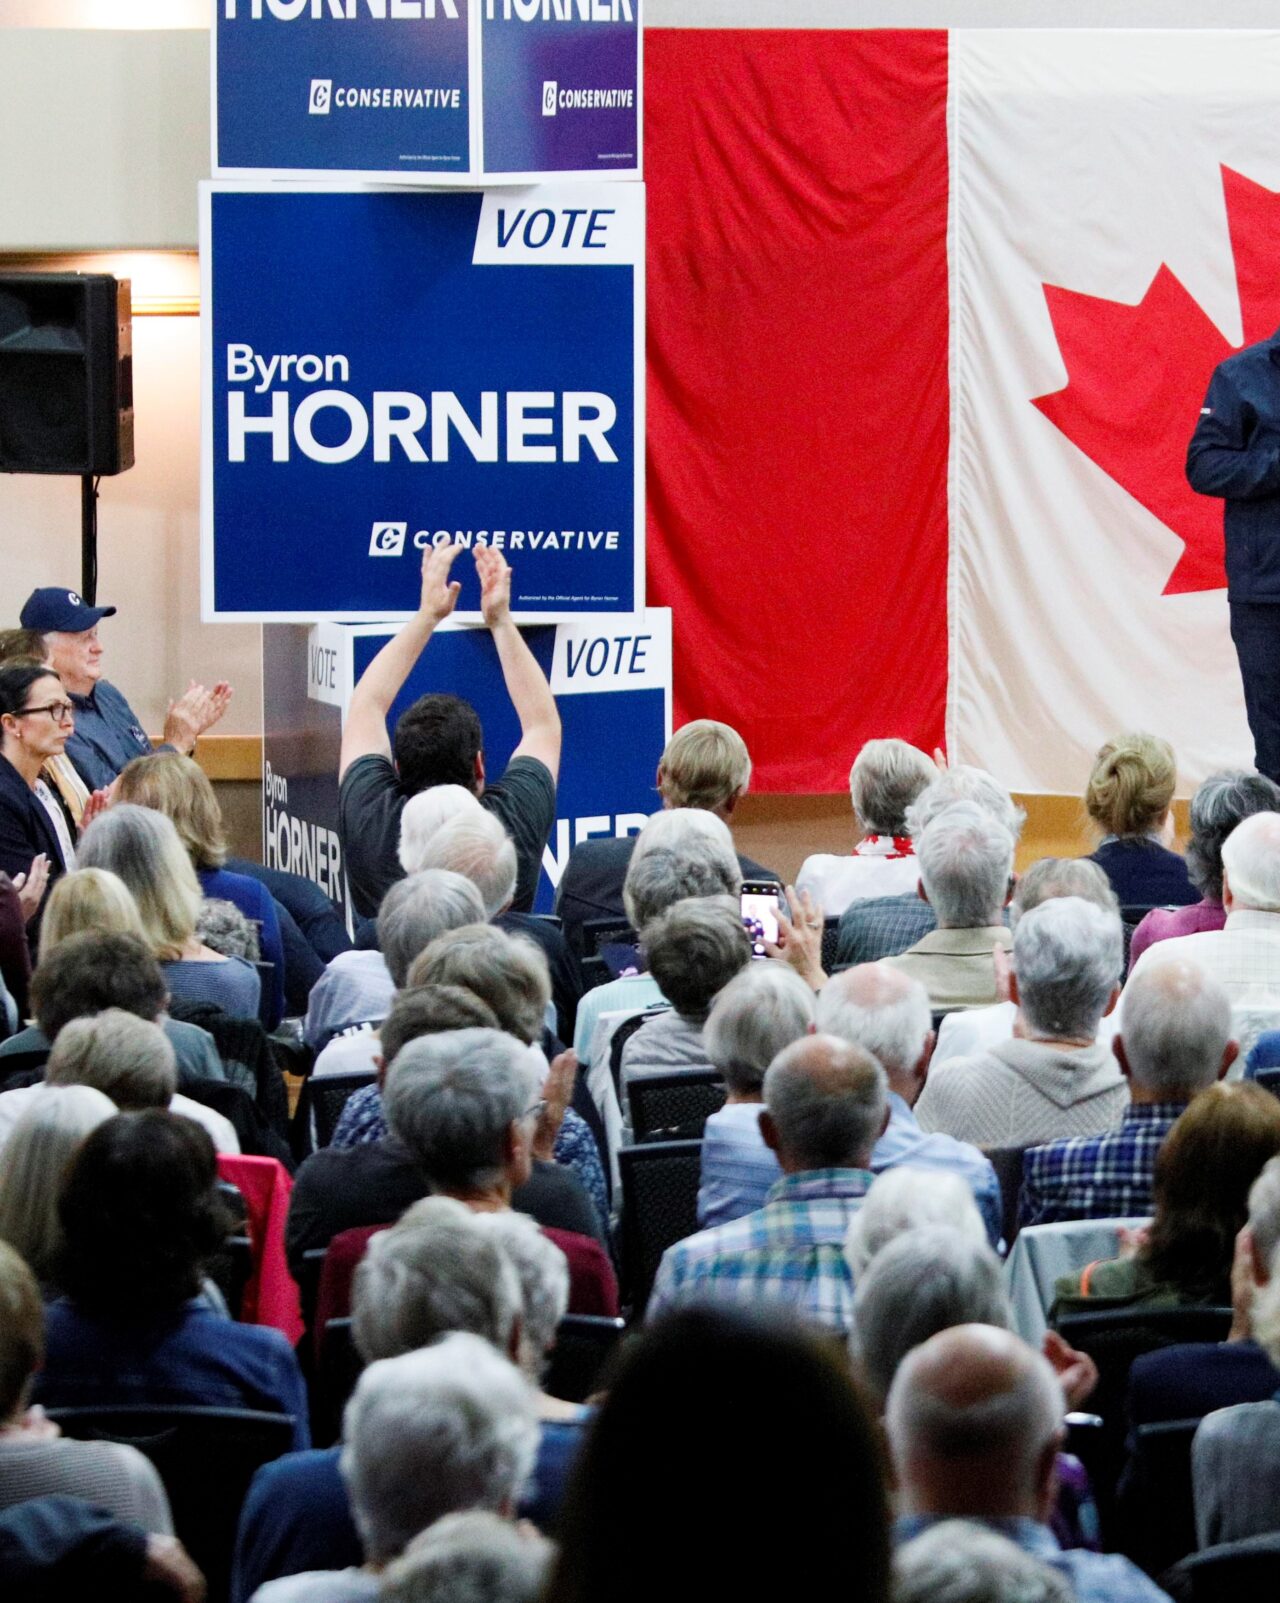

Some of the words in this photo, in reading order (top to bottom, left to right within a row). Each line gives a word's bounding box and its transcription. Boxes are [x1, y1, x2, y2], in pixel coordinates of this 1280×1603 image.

[335, 88, 461, 108] CONSERVATIVE
[559, 89, 633, 108] CONSERVATIVE
[497, 208, 616, 249] VOTE
[227, 343, 349, 393] Byron
[227, 389, 619, 464] HORNER
[413, 530, 620, 550] CONSERVATIVE
[311, 644, 337, 689] VOTE
[566, 635, 652, 678] VOTE
[265, 760, 288, 809] Byron
[266, 806, 342, 903] HORNER
